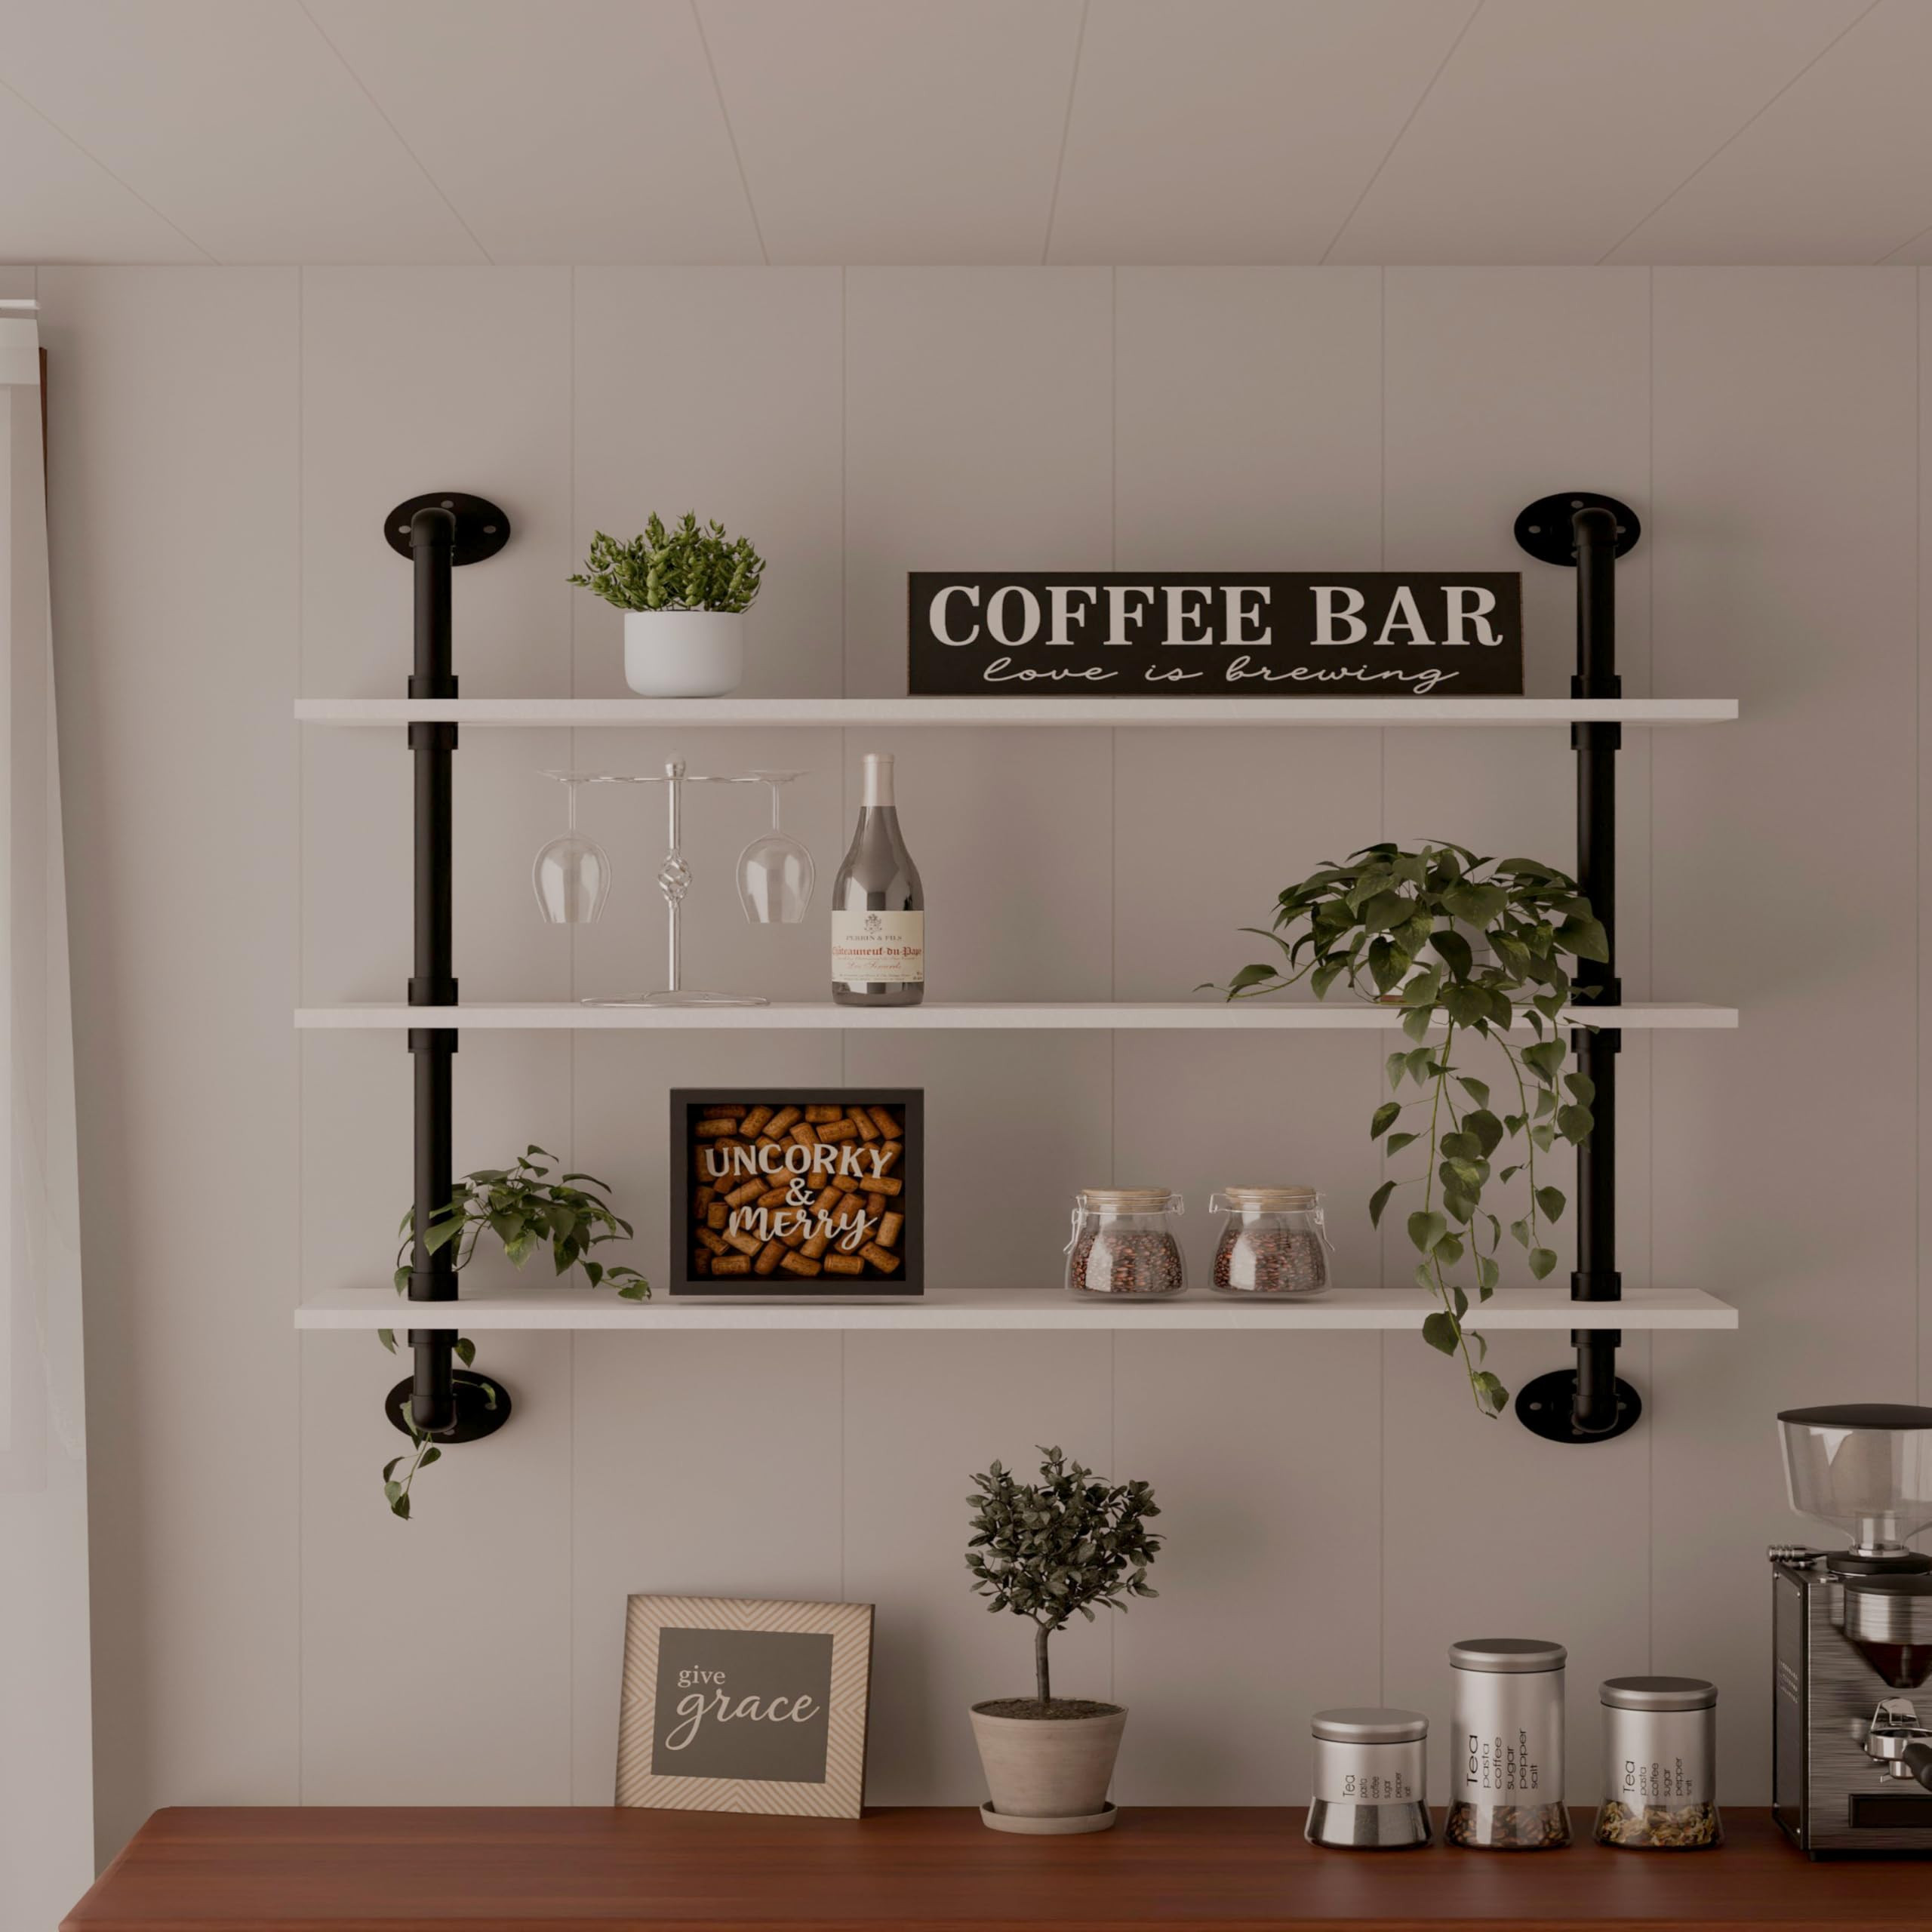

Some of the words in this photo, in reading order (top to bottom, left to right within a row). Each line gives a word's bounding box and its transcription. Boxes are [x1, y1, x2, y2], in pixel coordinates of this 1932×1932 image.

[928, 586, 1272, 647] COFFEE
[1309, 586, 1504, 647] BAR
[983, 657, 1118, 682] love
[1144, 661, 1204, 682] is
[1225, 654, 1460, 694] brewing
[704, 1143, 894, 1179] UNCORKY
[785, 1177, 816, 1207] &
[677, 1665, 726, 1688] give
[665, 1688, 820, 1751] grace
[1467, 1734, 1478, 1786] Tea
[1482, 1743, 1491, 1788] pasta
[1494, 1737, 1502, 1789] coffee
[1507, 1746, 1516, 1789] sugar
[1520, 1728, 1528, 1789] pepper
[1343, 1774, 1355, 1797] Tea
[1359, 1778, 1367, 1798] pasta
[1371, 1776, 1380, 1799] coffee
[1530, 1764, 1538, 1789] salt
[1623, 1760, 1635, 1793] Tea
[1639, 1767, 1648, 1796] pasta
[1650, 1762, 1659, 1796] coffee
[1664, 1769, 1672, 1796] sugar
[1675, 1758, 1684, 1796] pepper
